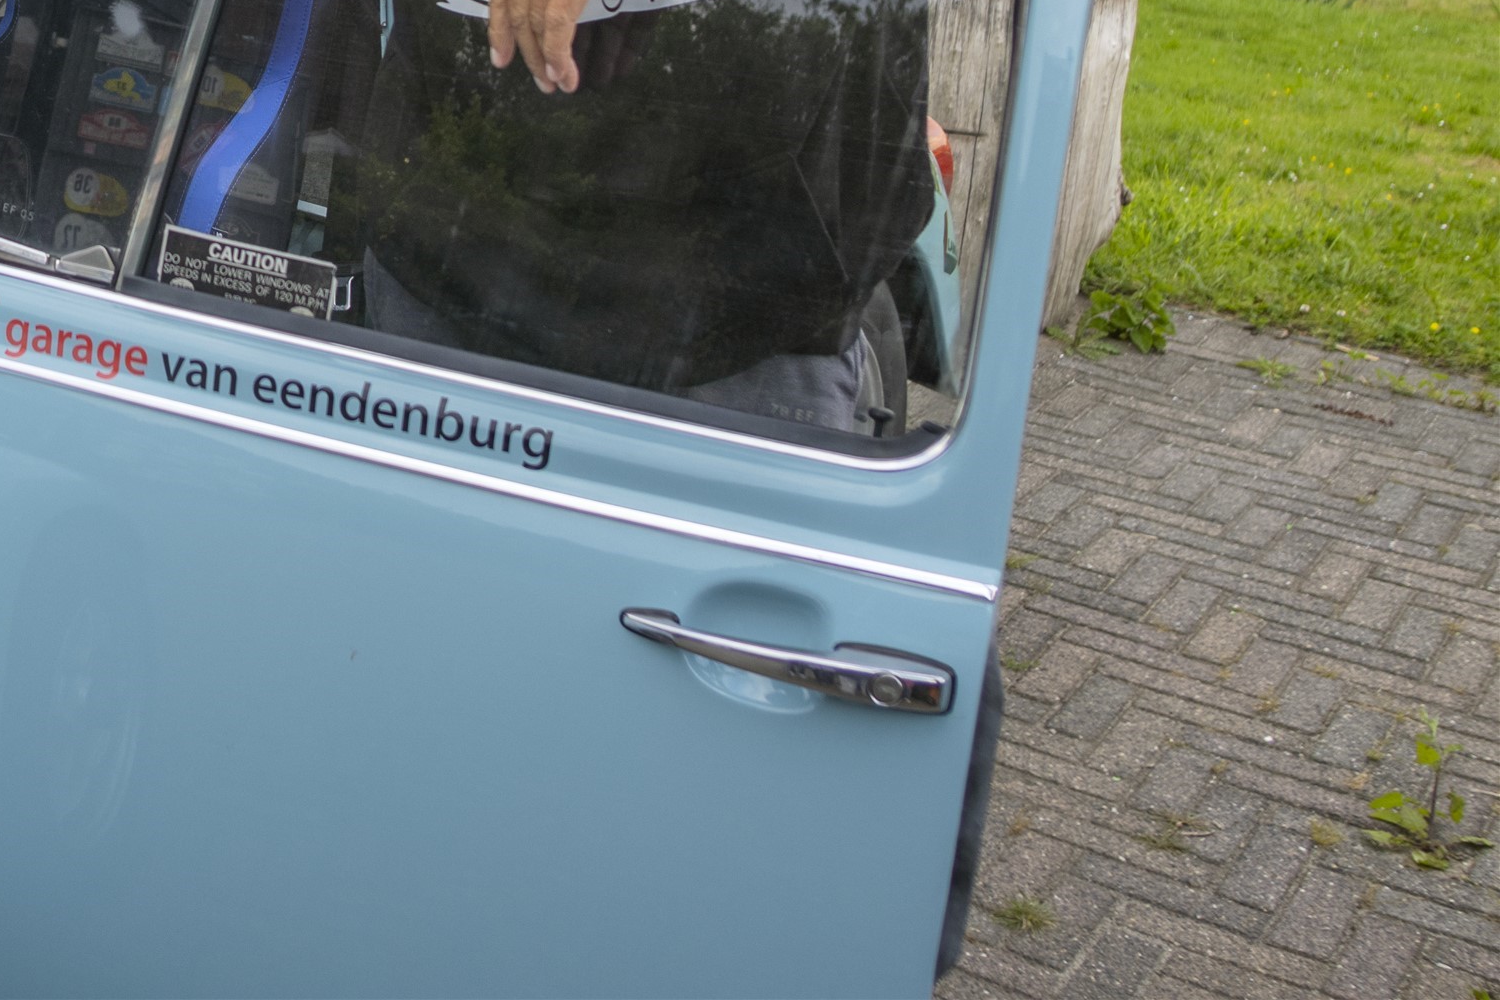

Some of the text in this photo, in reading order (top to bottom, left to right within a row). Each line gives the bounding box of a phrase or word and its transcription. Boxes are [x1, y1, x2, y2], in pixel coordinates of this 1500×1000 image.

[164, 251, 331, 300] DO NOT LOWER WINDOWS AT
[208, 243, 288, 275] CAUTION
[163, 263, 200, 282] SPEEDS
[201, 271, 212, 284] IN
[213, 275, 252, 295] EXCESS
[255, 284, 271, 298] OF
[274, 288, 293, 304] 120
[4, 316, 554, 471] garage van eendenburg
